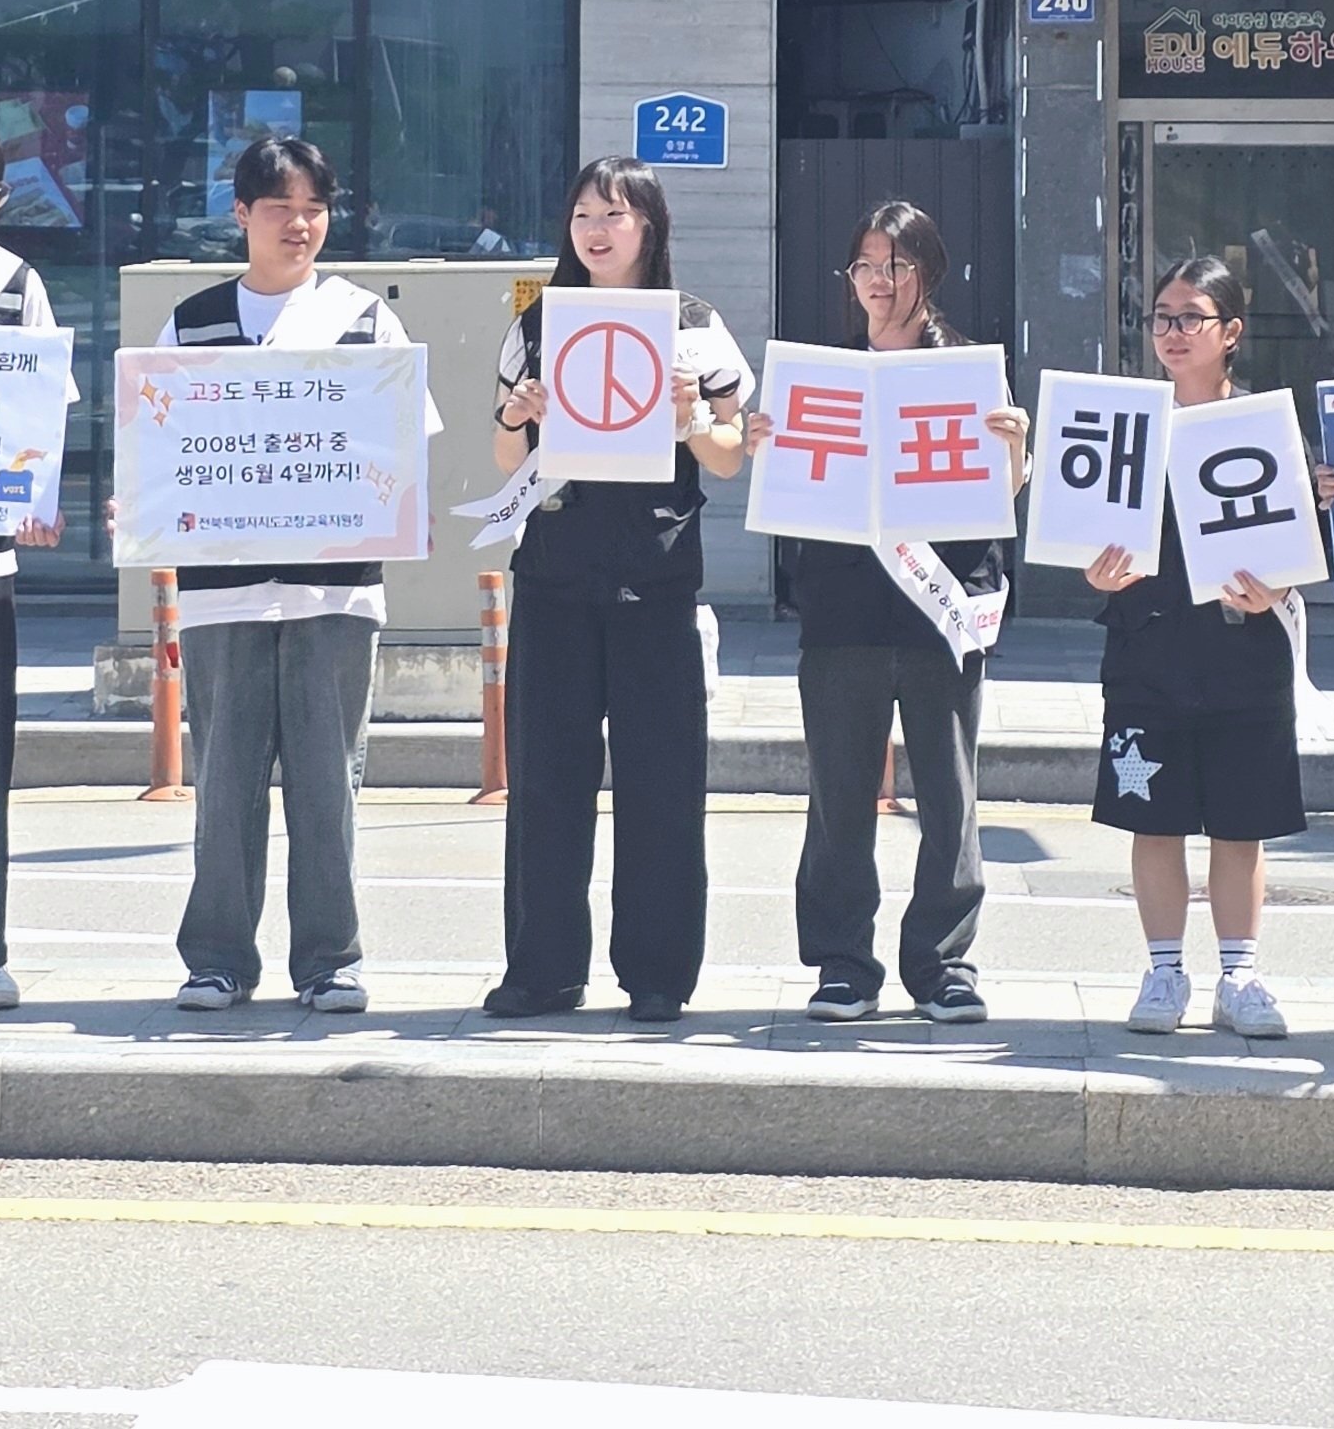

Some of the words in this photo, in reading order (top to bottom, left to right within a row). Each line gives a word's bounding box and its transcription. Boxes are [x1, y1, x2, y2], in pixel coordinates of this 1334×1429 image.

[1145, 32, 1205, 58] EDU
[1146, 57, 1205, 73] HOUSE
[655, 106, 706, 133] 242
[186, 381, 245, 403] 고3도
[251, 380, 295, 402] 투표
[304, 379, 347, 402] 가능
[181, 434, 257, 455] 2008년
[264, 431, 323, 454] 출생자
[330, 431, 348, 453] 중
[774, 384, 990, 485] 투표
[175, 464, 233, 486] 생일이
[240, 463, 274, 485] 6월
[280, 462, 361, 483] 4일까지!
[1061, 410, 1150, 510] 해
[1199, 446, 1296, 535] 요
